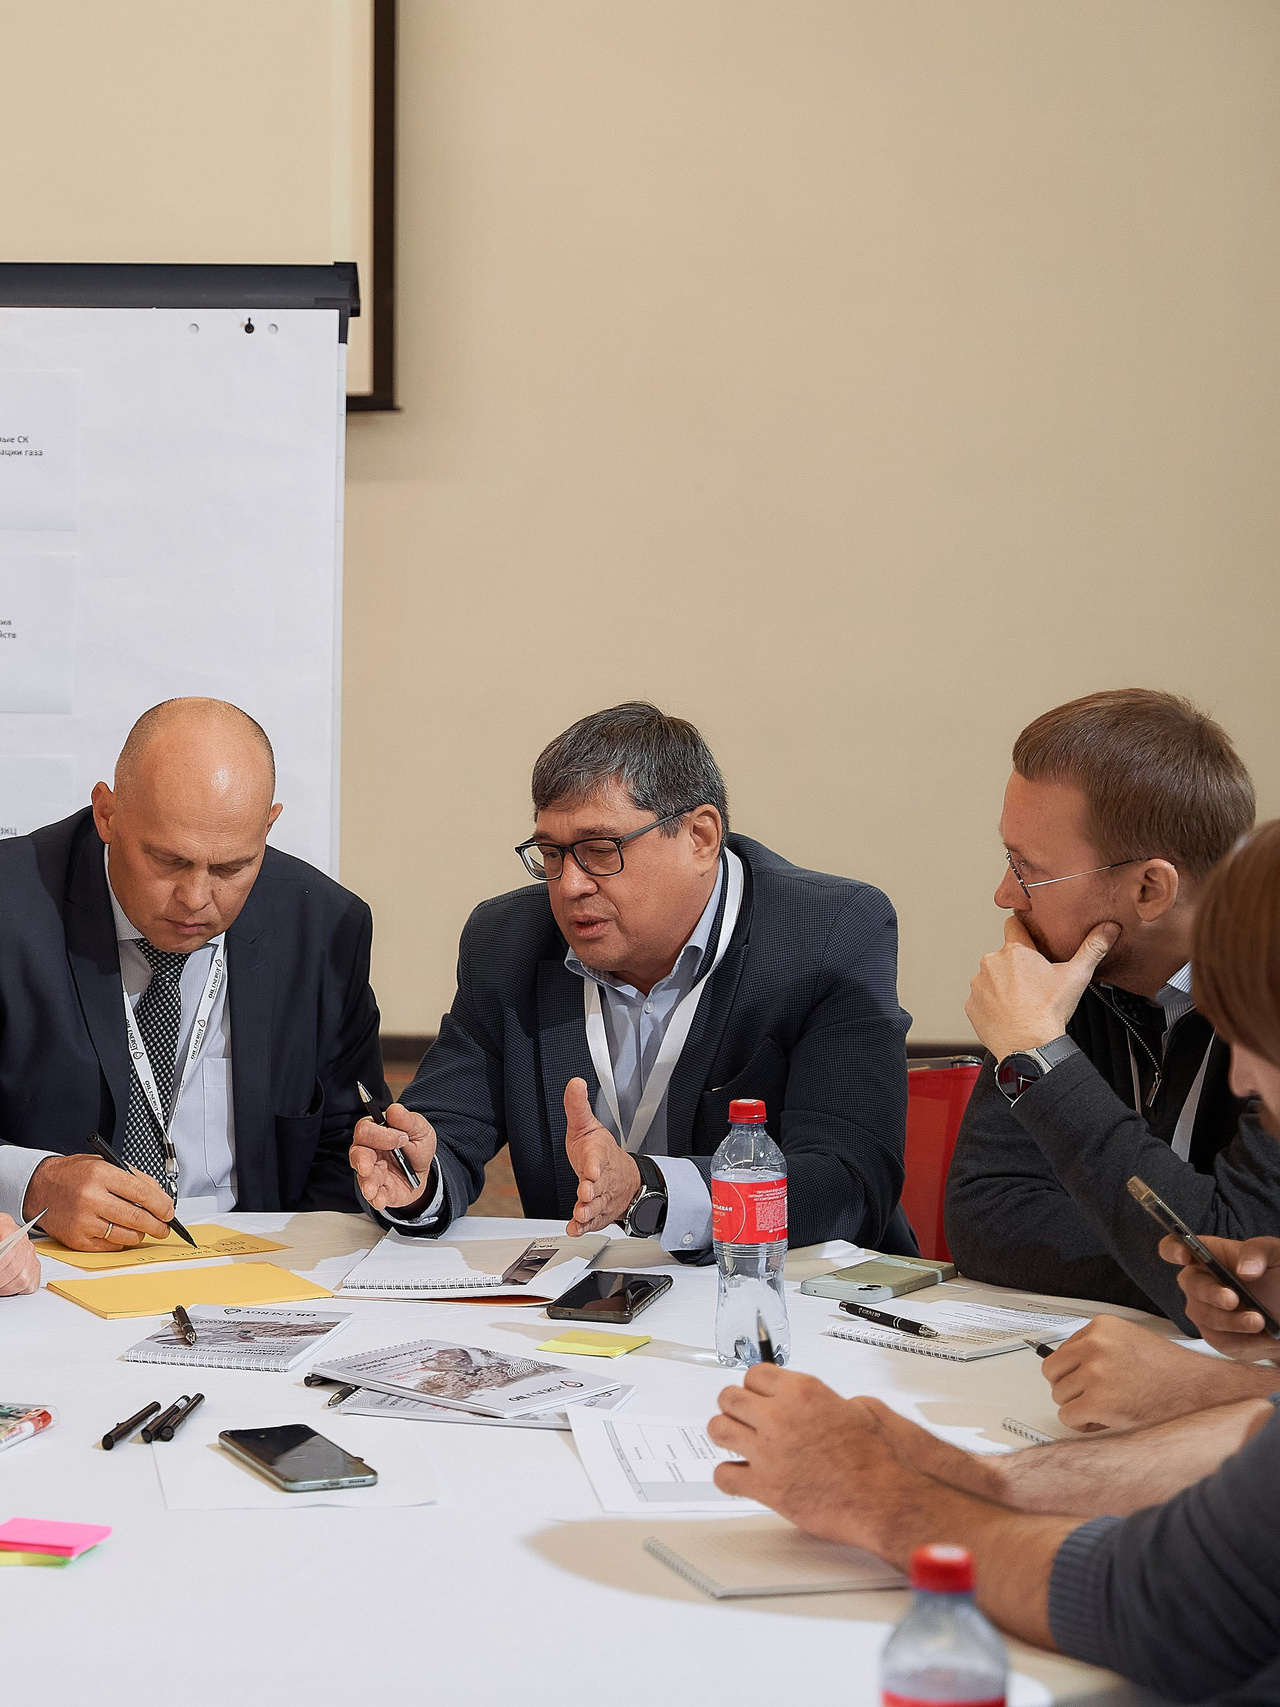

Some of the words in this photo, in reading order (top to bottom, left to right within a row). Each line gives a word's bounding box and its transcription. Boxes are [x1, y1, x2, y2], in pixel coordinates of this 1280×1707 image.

[17, 435, 29, 443] СК
[211, 967, 222, 989] ENERGY
[128, 1029, 139, 1051] ENERGY
[193, 1028, 204, 1050] ENERGY
[144, 1080, 152, 1090] OIL
[147, 1090, 159, 1112] ENERGY
[528, 1384, 566, 1398] ENERGY
